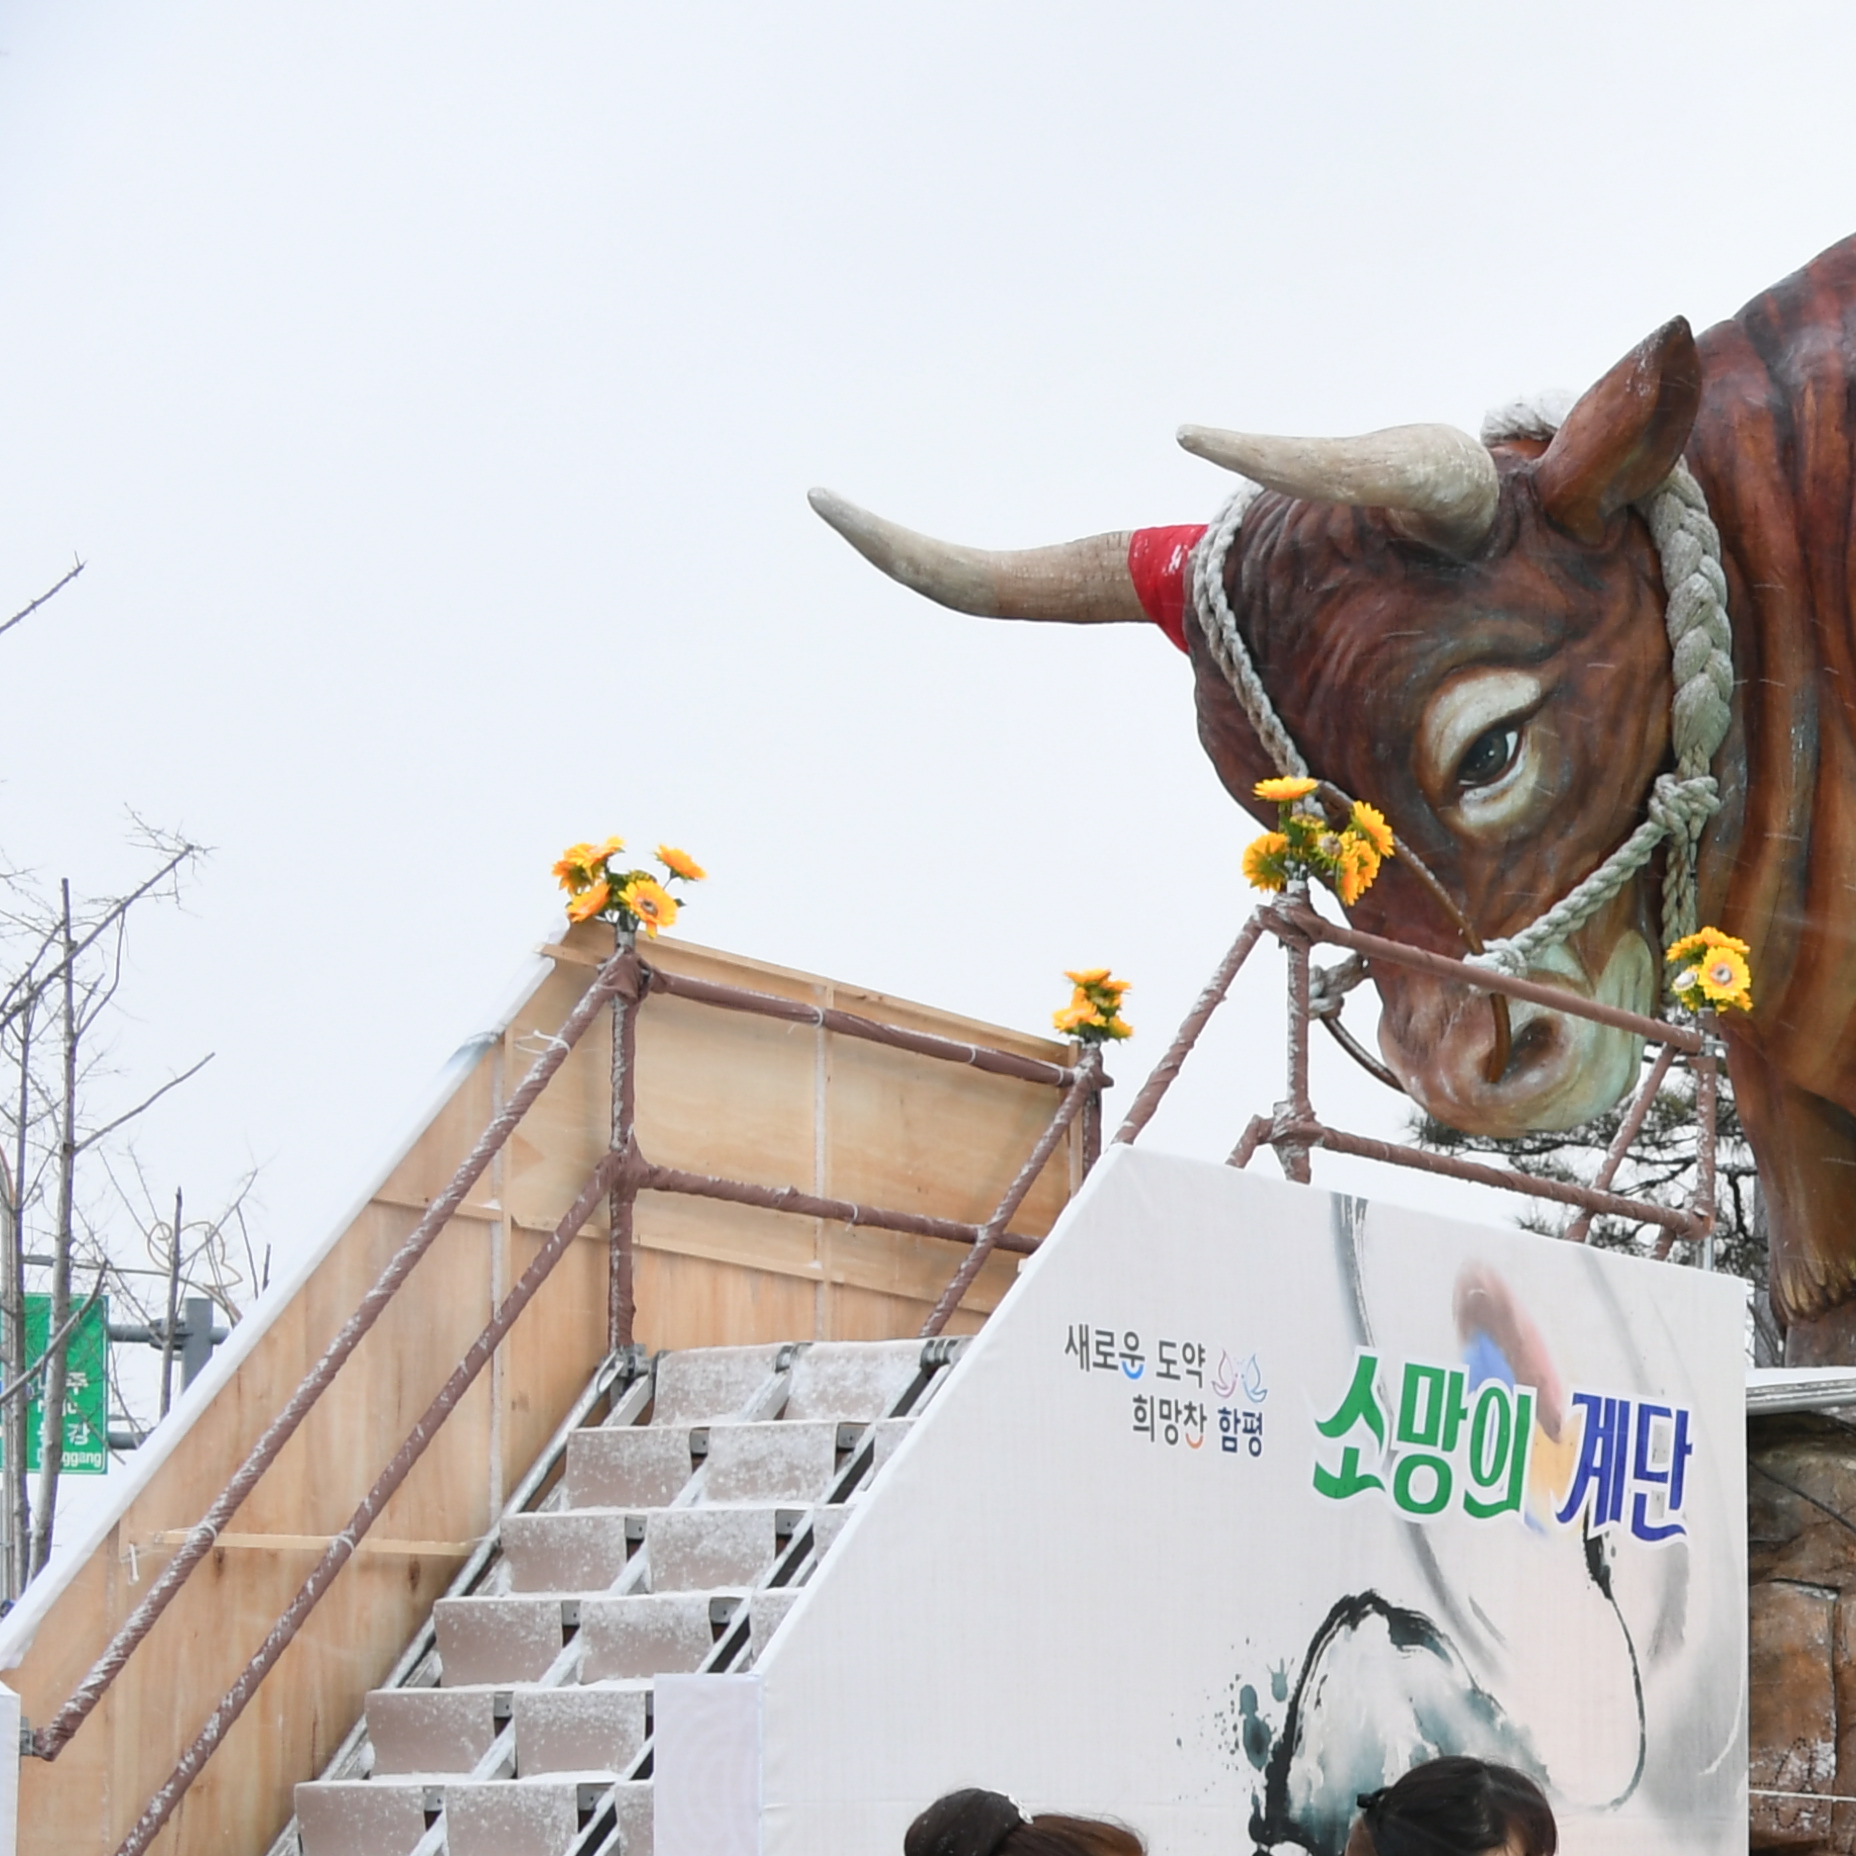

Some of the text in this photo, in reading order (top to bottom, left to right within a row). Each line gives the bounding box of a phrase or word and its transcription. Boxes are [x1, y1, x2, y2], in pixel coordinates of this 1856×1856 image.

[1064, 1323, 1206, 1389] 새로운 도약
[37, 1422, 90, 1445] 강
[1132, 1394, 1263, 1457] 희망찬 함평
[1312, 1355, 1693, 1542] 소망의 계단
